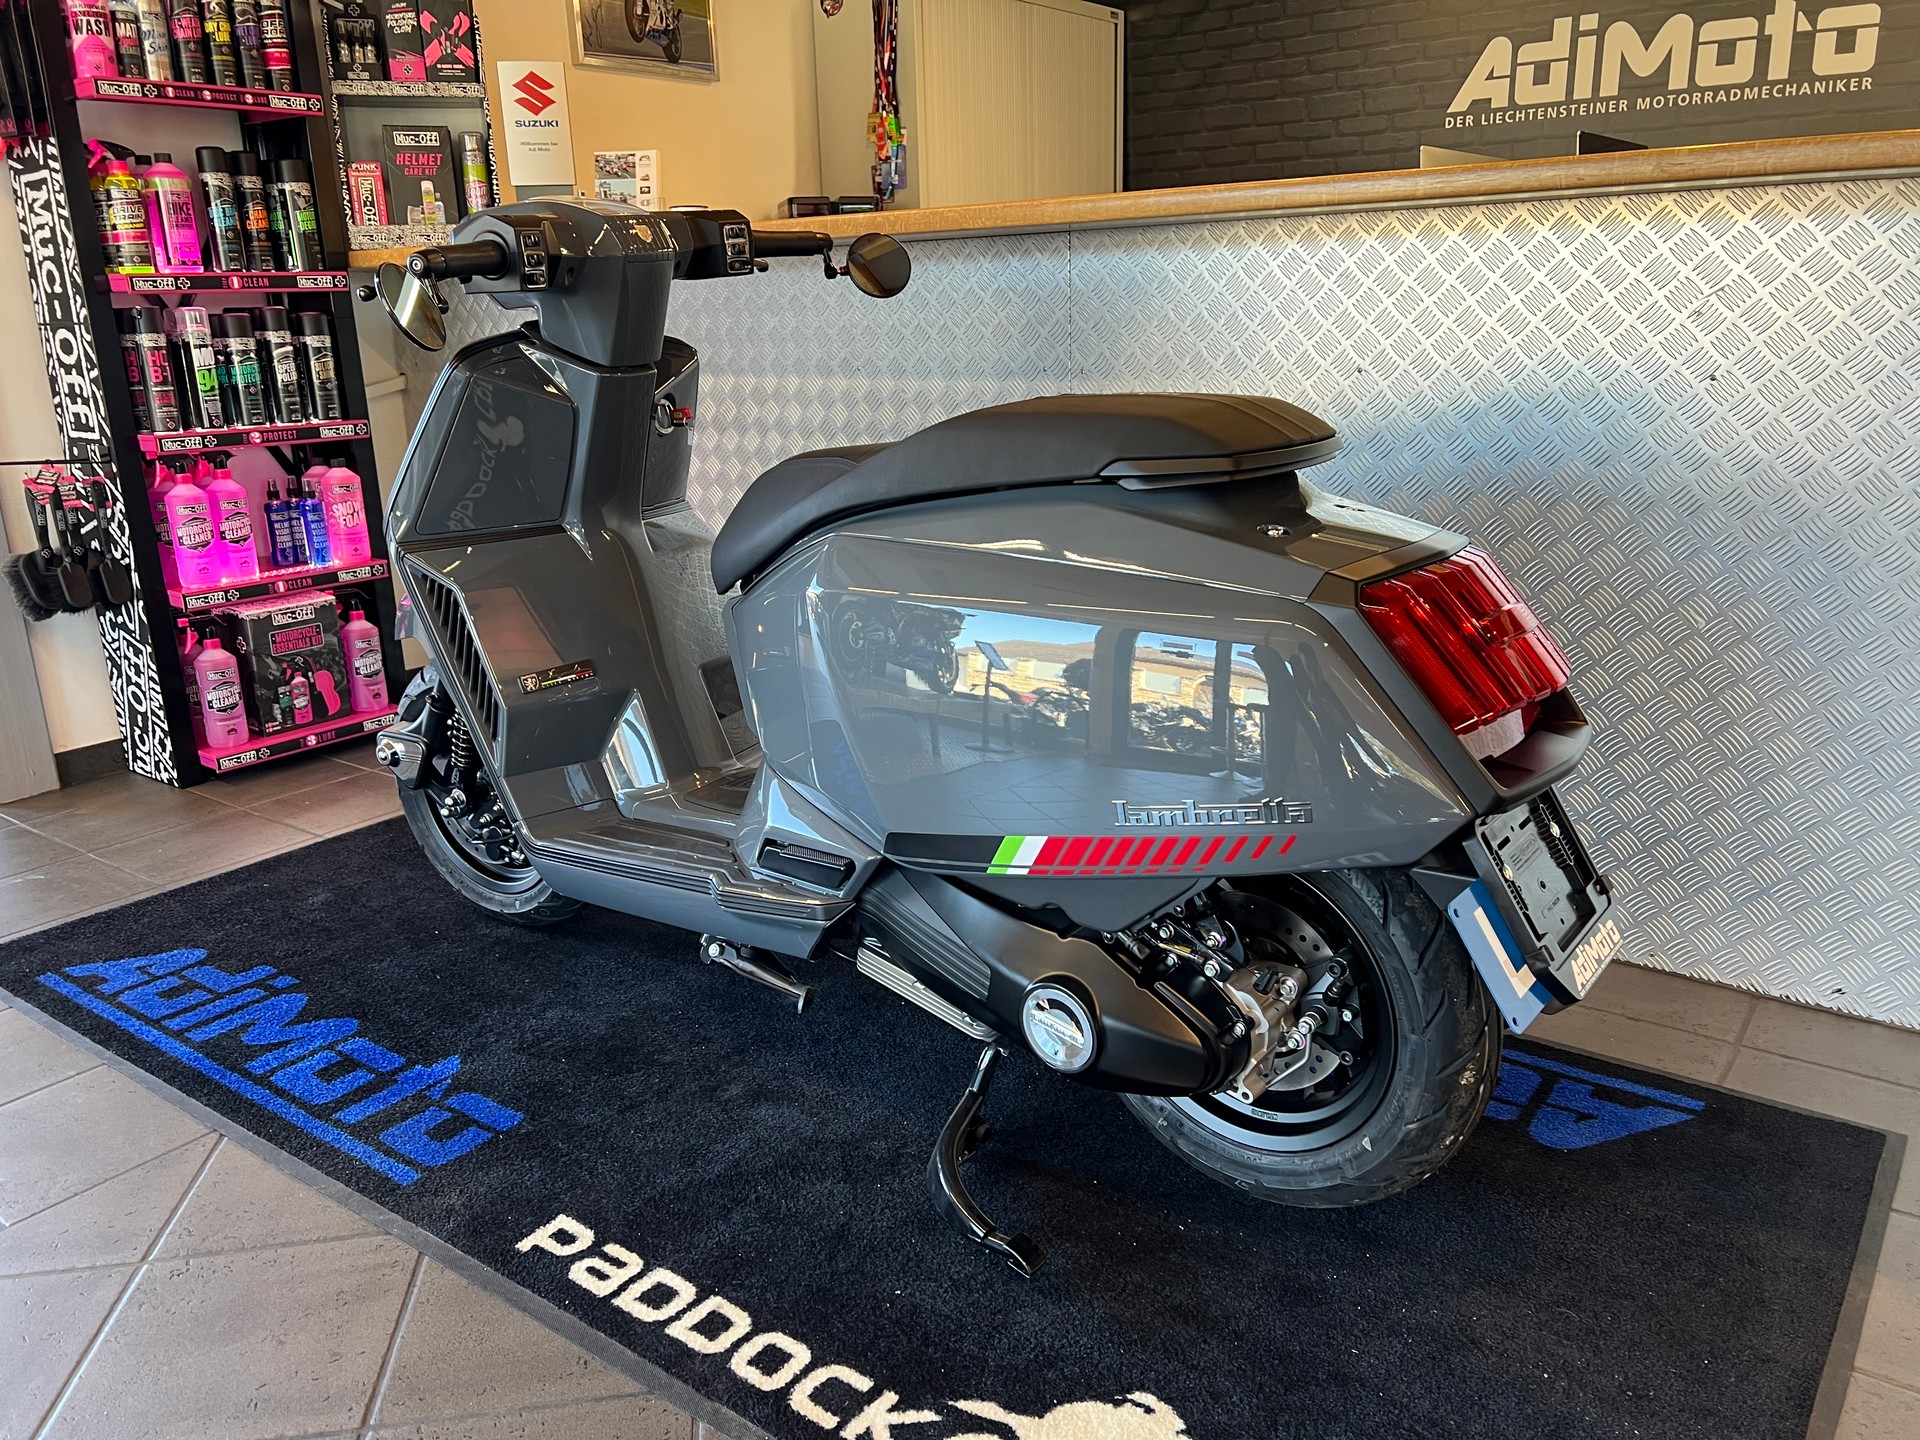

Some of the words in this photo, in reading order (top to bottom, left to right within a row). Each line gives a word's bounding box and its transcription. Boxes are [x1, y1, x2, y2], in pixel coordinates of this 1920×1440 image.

[72, 18, 111, 37] WASH
[1446, 0, 1881, 113] AdiMoto
[100, 82, 140, 95] Muc-Off
[271, 97, 306, 109] Muc-Off
[1444, 115, 1474, 129] DER
[1480, 99, 1629, 126] LIECHTENSTEINER
[1636, 77, 1874, 109] MOTORRADMECHANIKER
[515, 120, 559, 128] SUZUKI
[396, 133, 438, 145] Muc-Off
[352, 163, 377, 172] PUNK
[396, 153, 443, 166] HELMET
[404, 168, 422, 176] CARE
[426, 168, 437, 176] KIT
[112, 206, 142, 214] DRIVE
[135, 278, 174, 289] Muc-Off
[243, 278, 269, 287] CLEAN
[299, 277, 333, 287] Muc-Off
[28, 186, 93, 430] Muc-Off
[164, 438, 200, 450] Muc-Off
[264, 430, 297, 441] PROTECT
[322, 425, 354, 437] Muc-Off
[332, 500, 365, 518] SNOW
[183, 530, 212, 545] CLEANER
[188, 594, 225, 607] Muc-Off
[288, 578, 313, 589] CLEAN
[339, 569, 371, 581] Muc-Off
[274, 607, 313, 624] Muc-Off
[274, 625, 318, 643] MOTORCYCLE
[272, 637, 311, 654] ESSENTIALS
[312, 634, 323, 646] KIT
[123, 643, 152, 778] uc-Off
[212, 694, 240, 709] CLEANER
[221, 752, 257, 769] Muc-Off
[318, 731, 336, 743] LUBE
[364, 714, 395, 730] Muc-Off
[1570, 918, 1622, 992] AdiMoto
[63, 946, 524, 1168] AdiMoto
